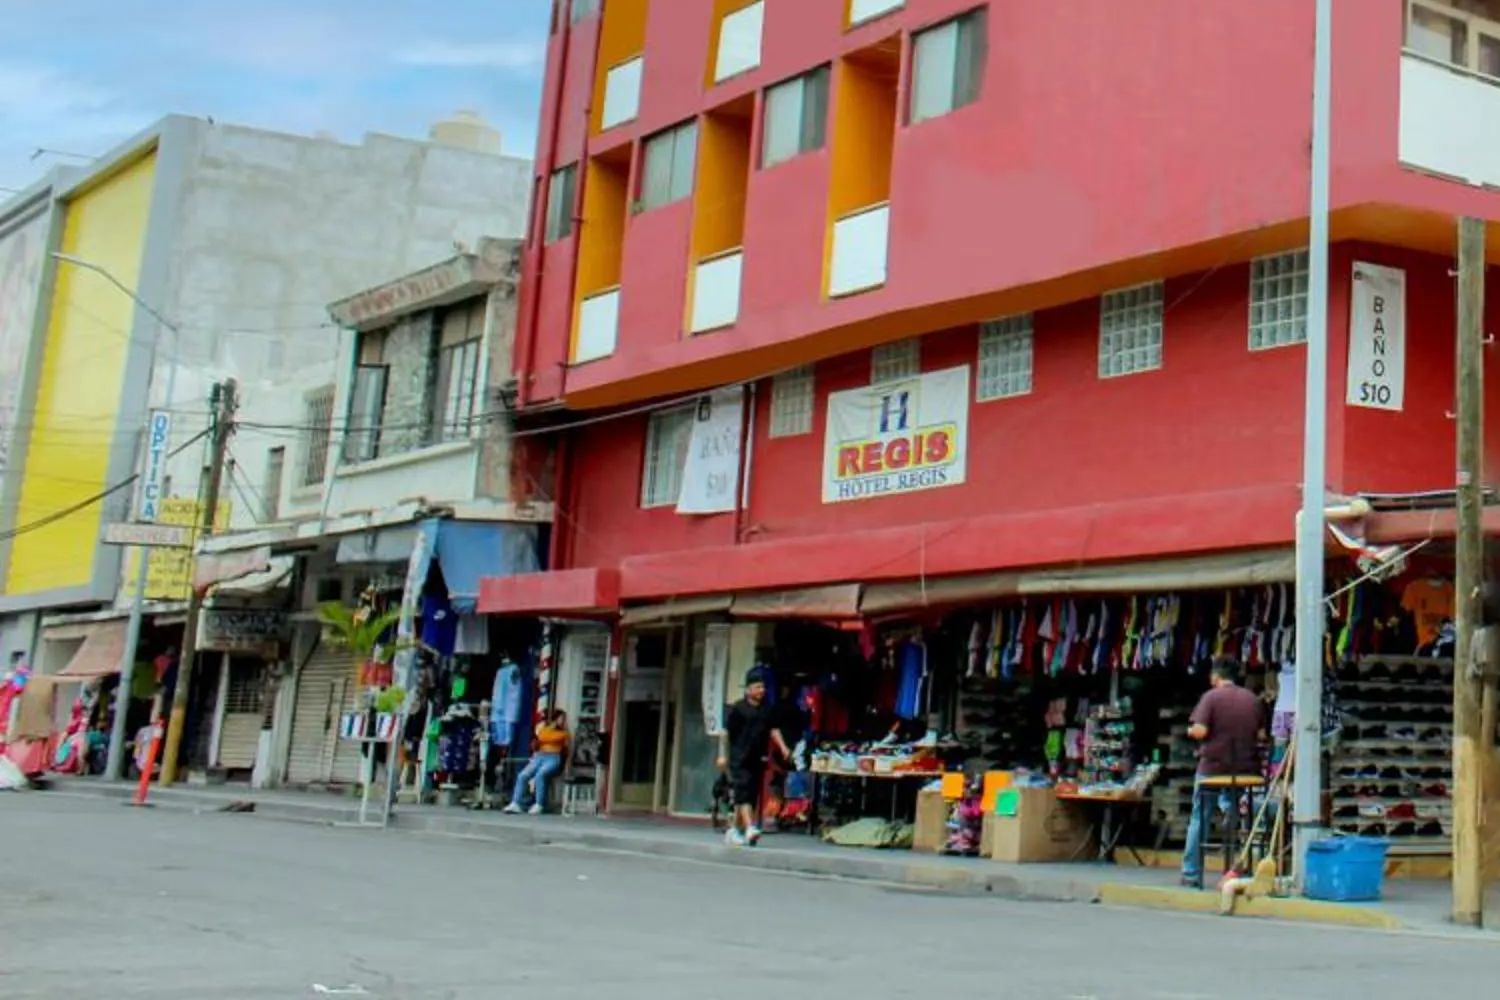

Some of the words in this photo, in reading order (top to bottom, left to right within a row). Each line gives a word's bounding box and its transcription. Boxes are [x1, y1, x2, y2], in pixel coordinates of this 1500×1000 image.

[879, 391, 909, 432] H
[837, 431, 949, 477] REGIS
[839, 478, 889, 497] HOTEL
[897, 465, 948, 489] REGIS
